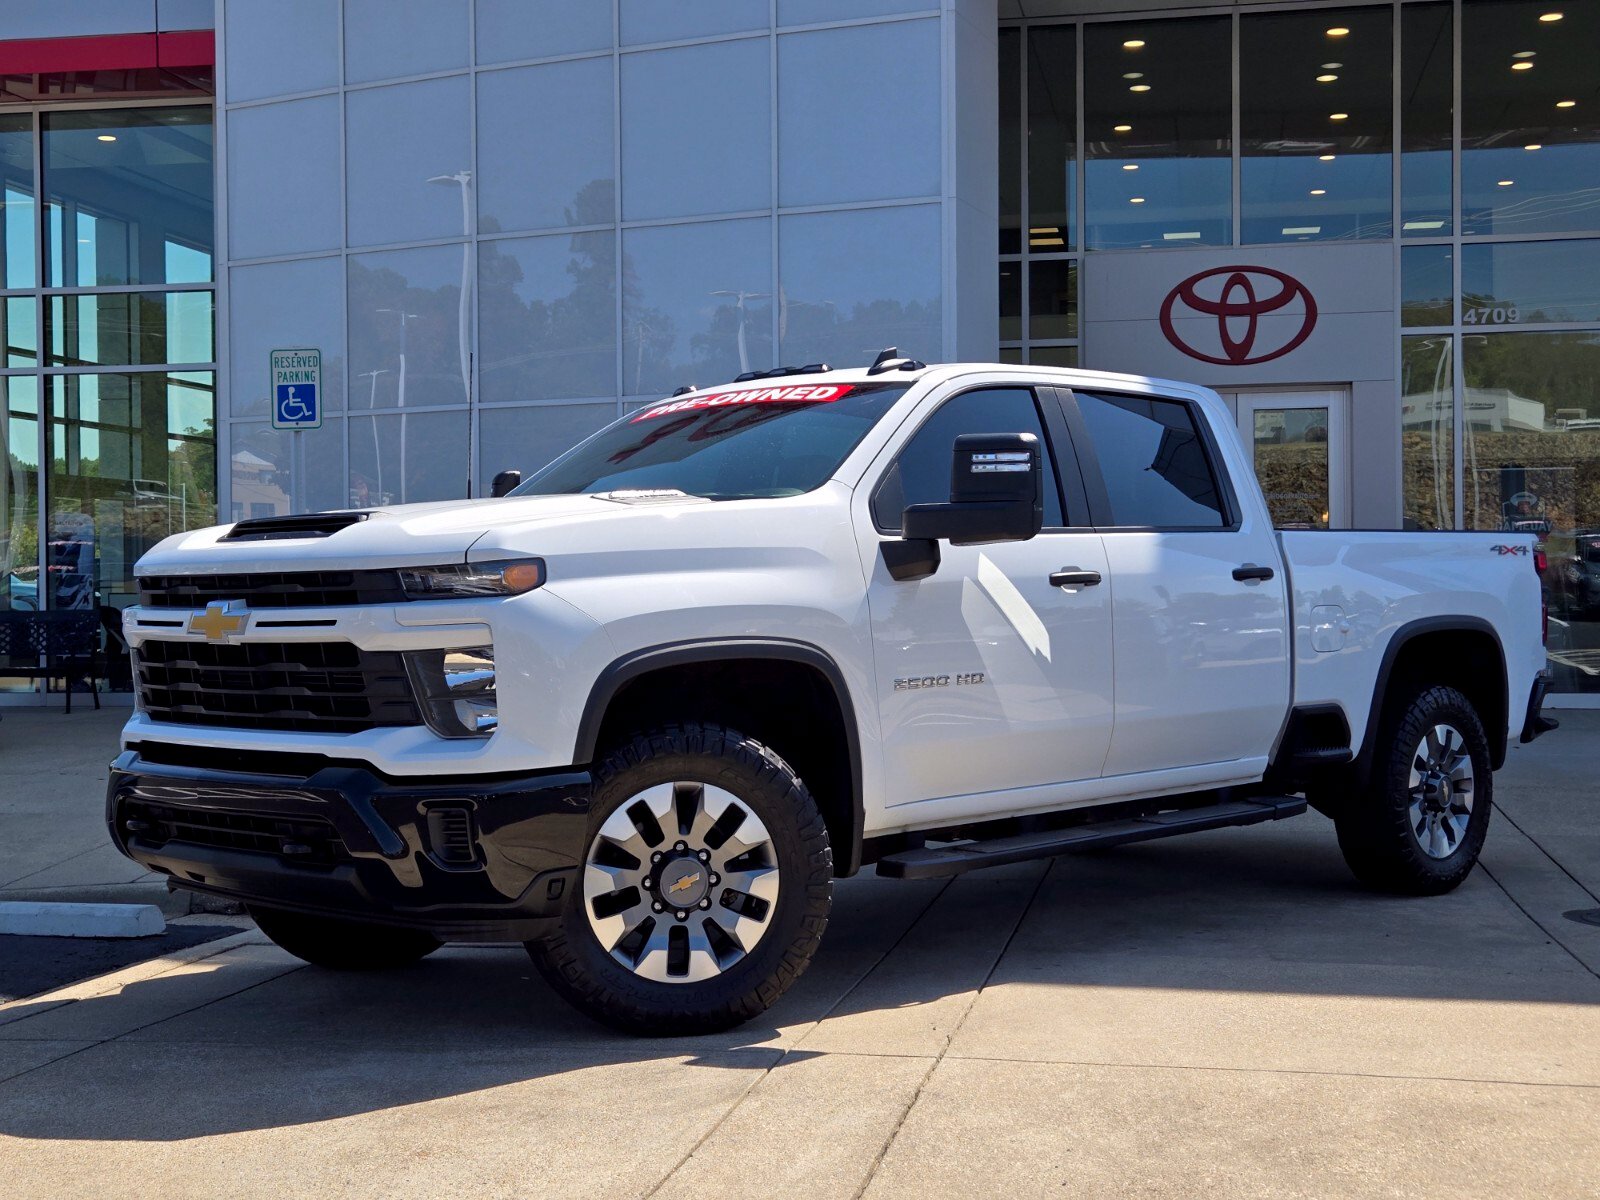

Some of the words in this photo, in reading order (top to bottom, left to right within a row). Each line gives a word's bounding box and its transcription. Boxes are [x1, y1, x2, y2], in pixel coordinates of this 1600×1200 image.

[1463, 308, 1520, 324] 4709
[274, 356, 318, 368] RESERVED
[277, 371, 316, 383] PARKING
[639, 386, 838, 420] PRE-OWNED
[894, 674, 950, 691] 2500
[956, 672, 985, 685] HD
